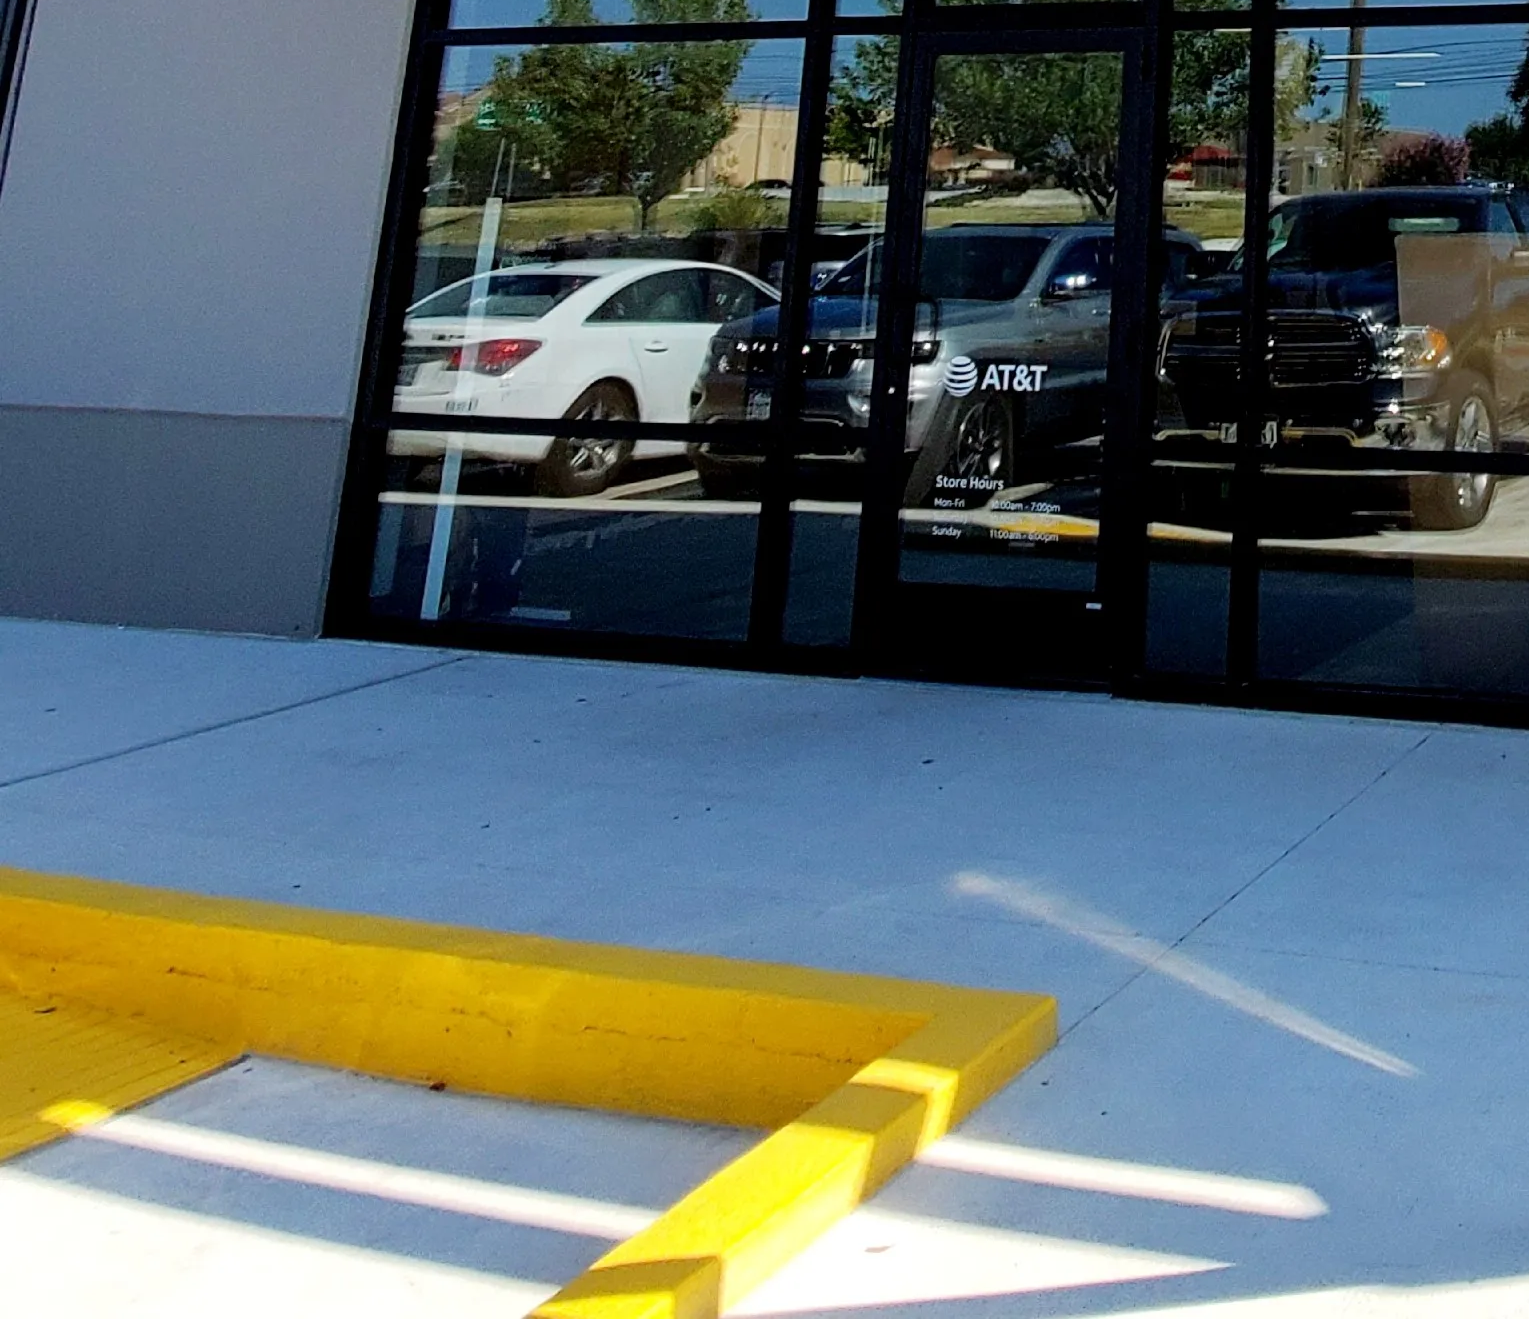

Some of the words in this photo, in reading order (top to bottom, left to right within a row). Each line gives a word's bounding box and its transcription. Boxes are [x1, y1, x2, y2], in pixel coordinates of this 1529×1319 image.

[981, 364, 1048, 392] AT&T
[936, 475, 967, 489] Store
[969, 476, 1004, 491] Hours
[934, 497, 966, 508] Mon-Fri
[932, 525, 962, 539] Sunday
